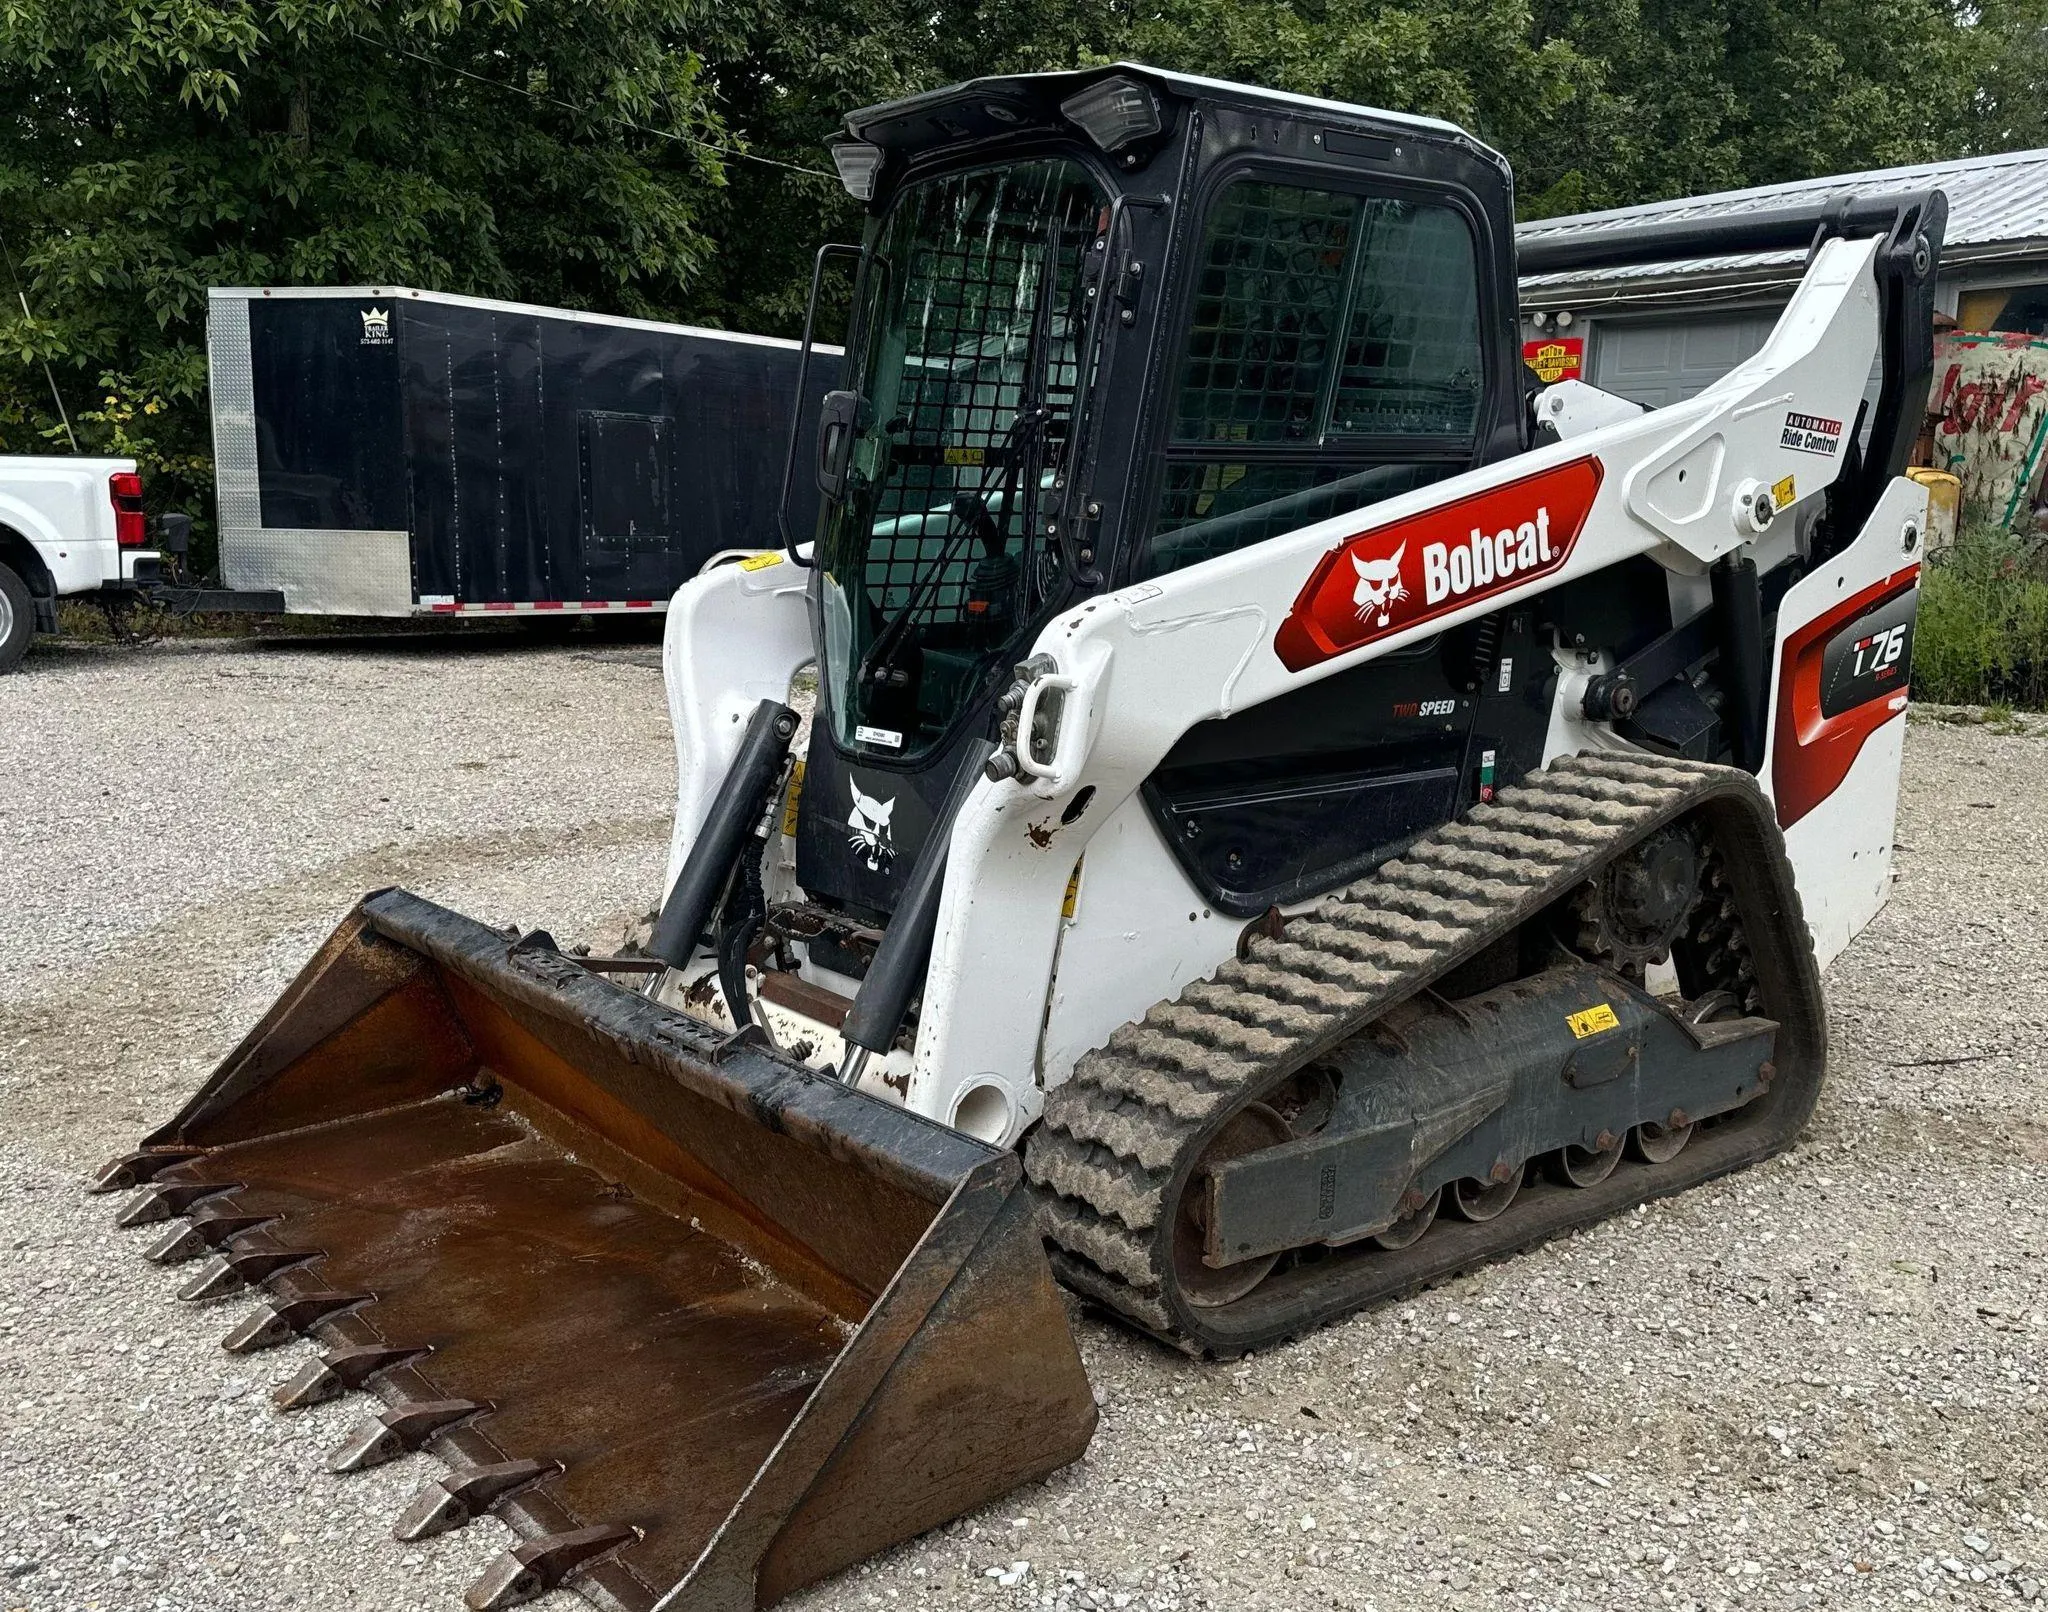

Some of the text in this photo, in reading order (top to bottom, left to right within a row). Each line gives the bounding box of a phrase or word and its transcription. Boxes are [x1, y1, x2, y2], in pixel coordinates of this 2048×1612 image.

[365, 330, 389, 338] KING
[1541, 346, 1563, 356] MOTOR
[1787, 414, 1840, 434] AUTOMATIC
[1780, 428, 1839, 453] Ride Control
[1422, 507, 1551, 605] Bobcat
[1853, 623, 1907, 677] T76
[1393, 699, 1455, 718] TWO SPEED
